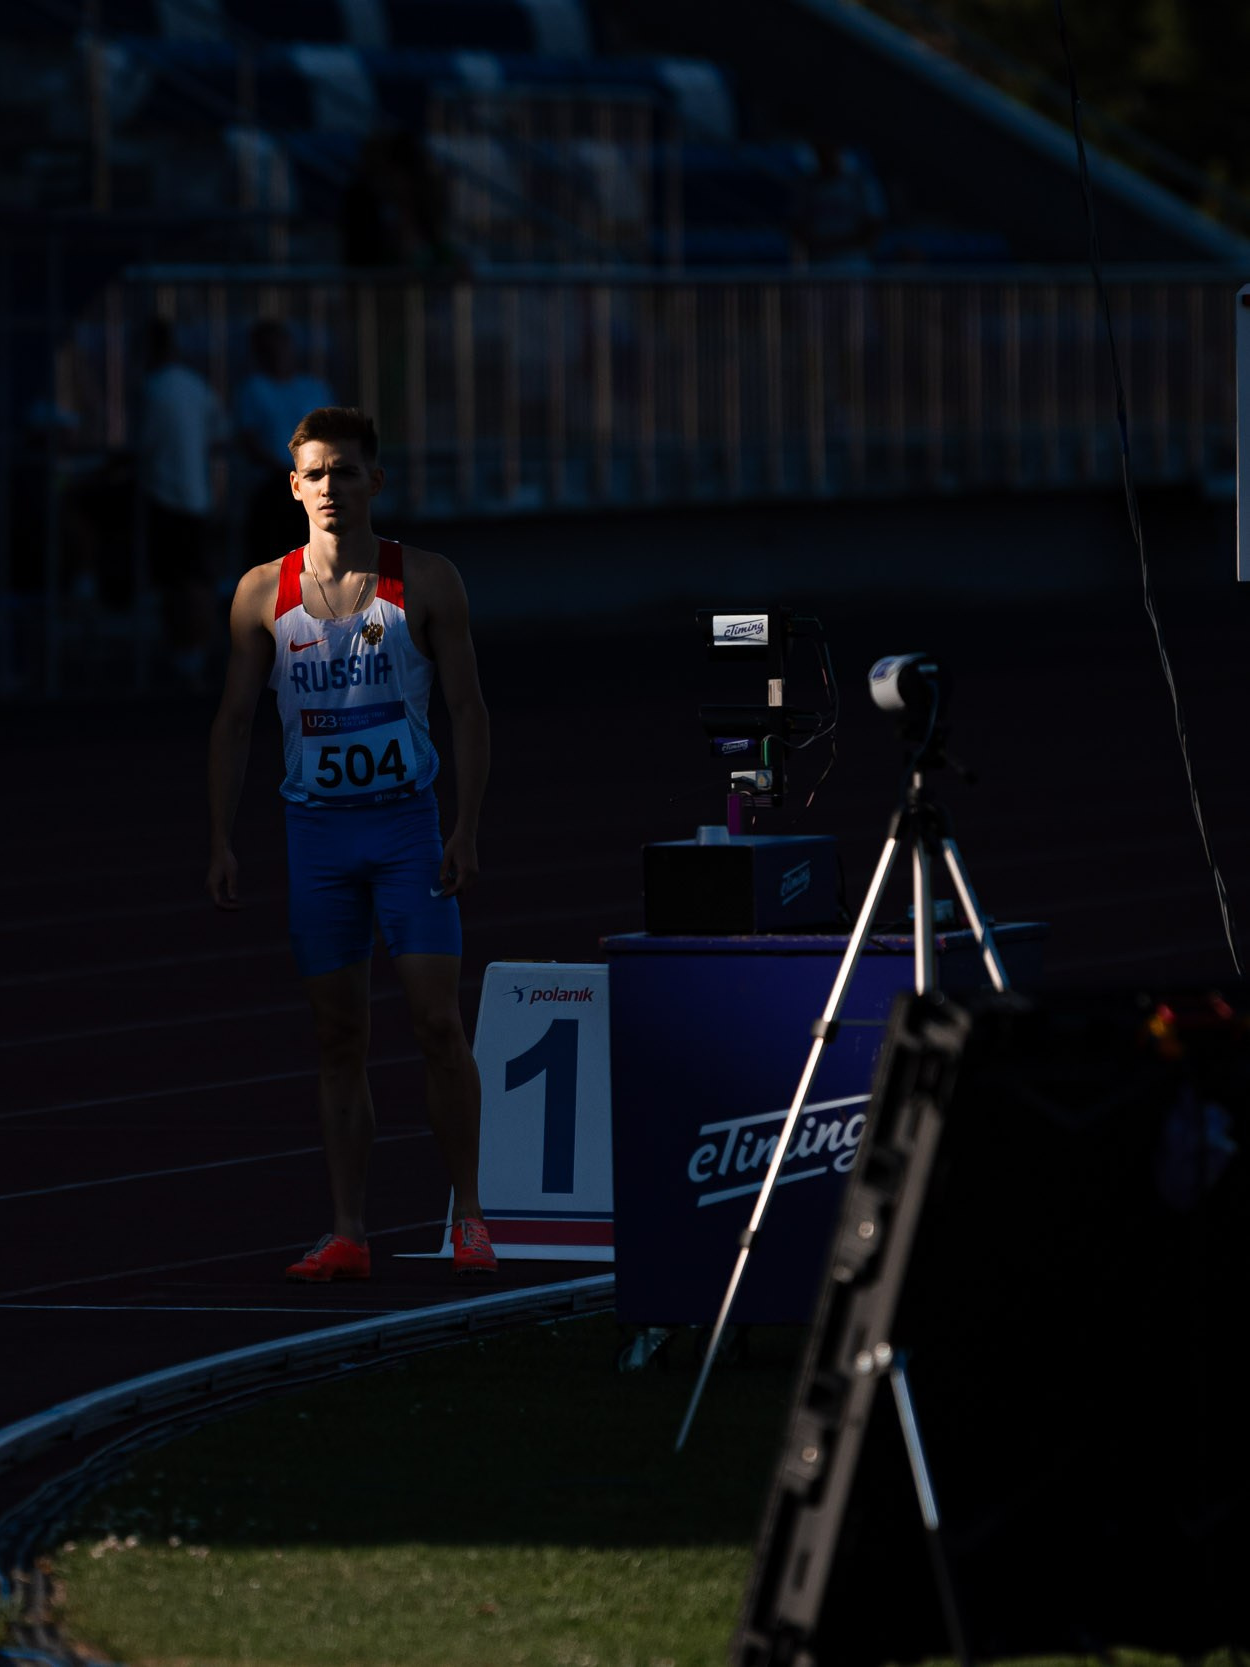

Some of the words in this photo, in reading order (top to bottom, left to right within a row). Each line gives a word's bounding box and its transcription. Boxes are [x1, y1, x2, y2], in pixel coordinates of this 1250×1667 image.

[724, 618, 765, 638] eTiming
[291, 653, 392, 693] RUSSIA
[306, 714, 337, 728] U23
[315, 739, 407, 788] 504
[530, 986, 594, 1005] polanik
[505, 1019, 579, 1194] 1
